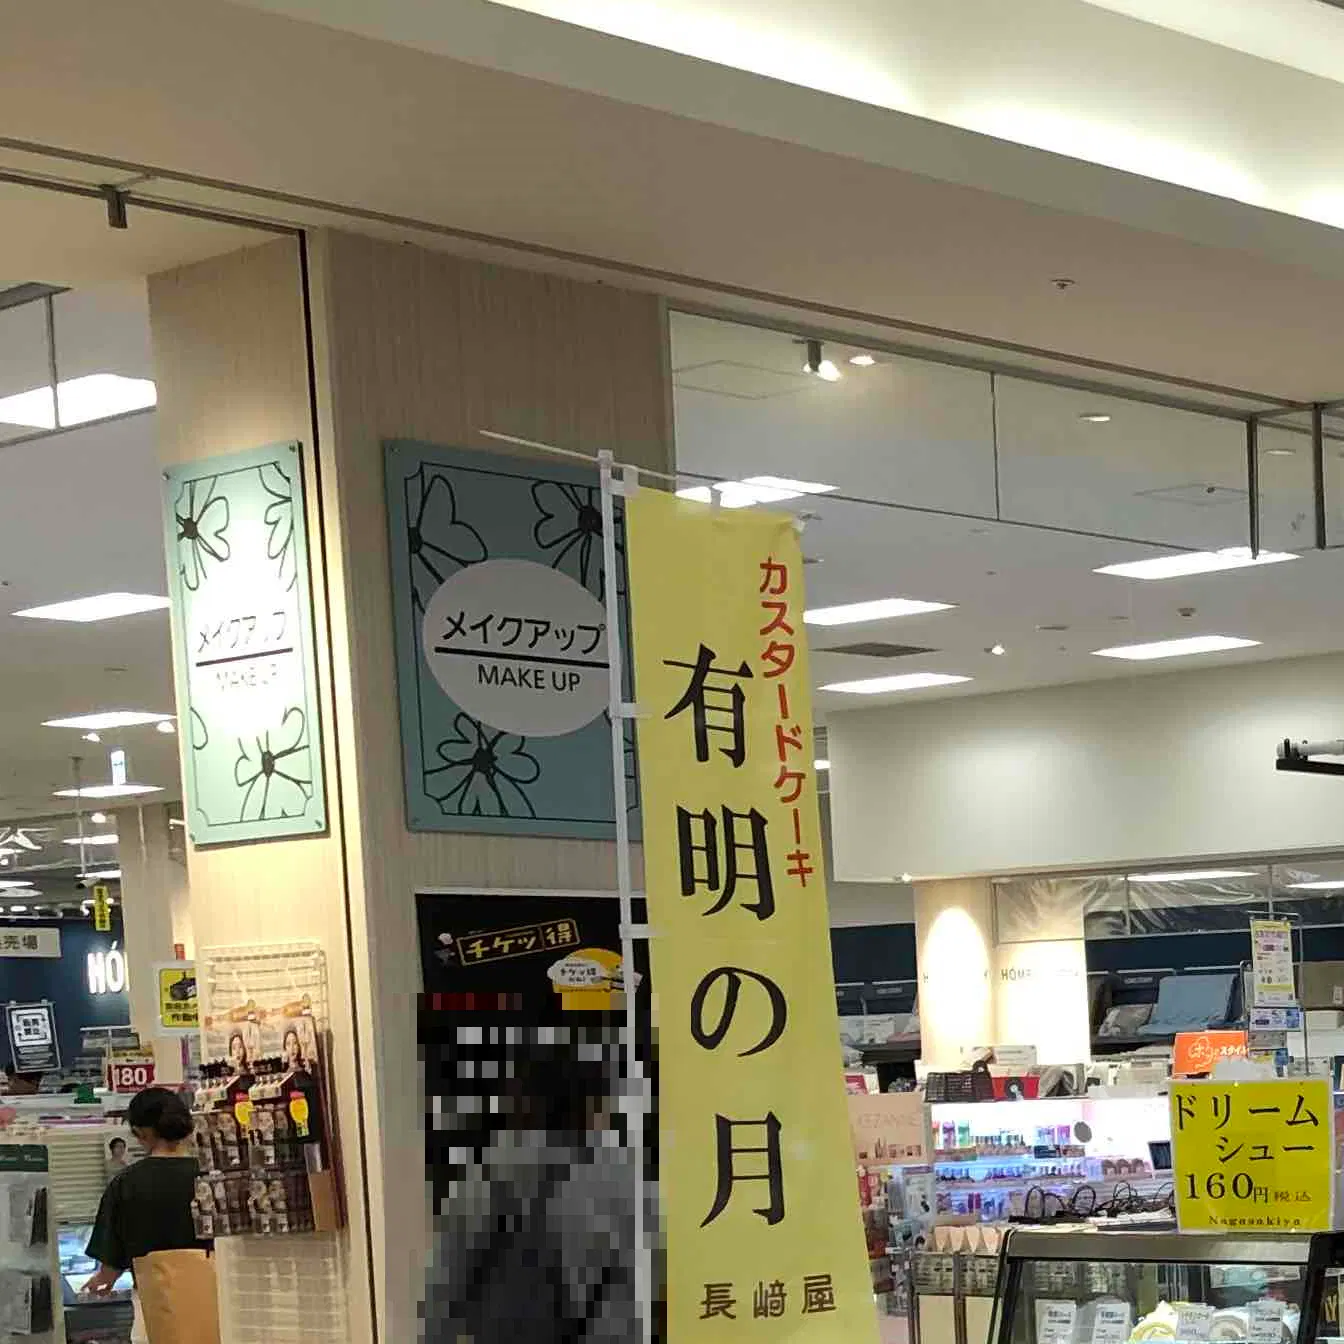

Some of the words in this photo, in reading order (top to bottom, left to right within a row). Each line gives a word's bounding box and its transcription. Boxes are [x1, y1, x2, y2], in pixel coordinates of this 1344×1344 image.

[441, 611, 606, 654] メイクアップ
[477, 663, 546, 691] MAKE
[551, 671, 582, 693] UP
[759, 555, 813, 888] カスタードケーキ
[0, 934, 38, 950] 売場
[662, 642, 787, 1228] 有明の月
[1176, 1094, 1319, 1131] ドリーム
[1215, 1135, 1315, 1164] シュー
